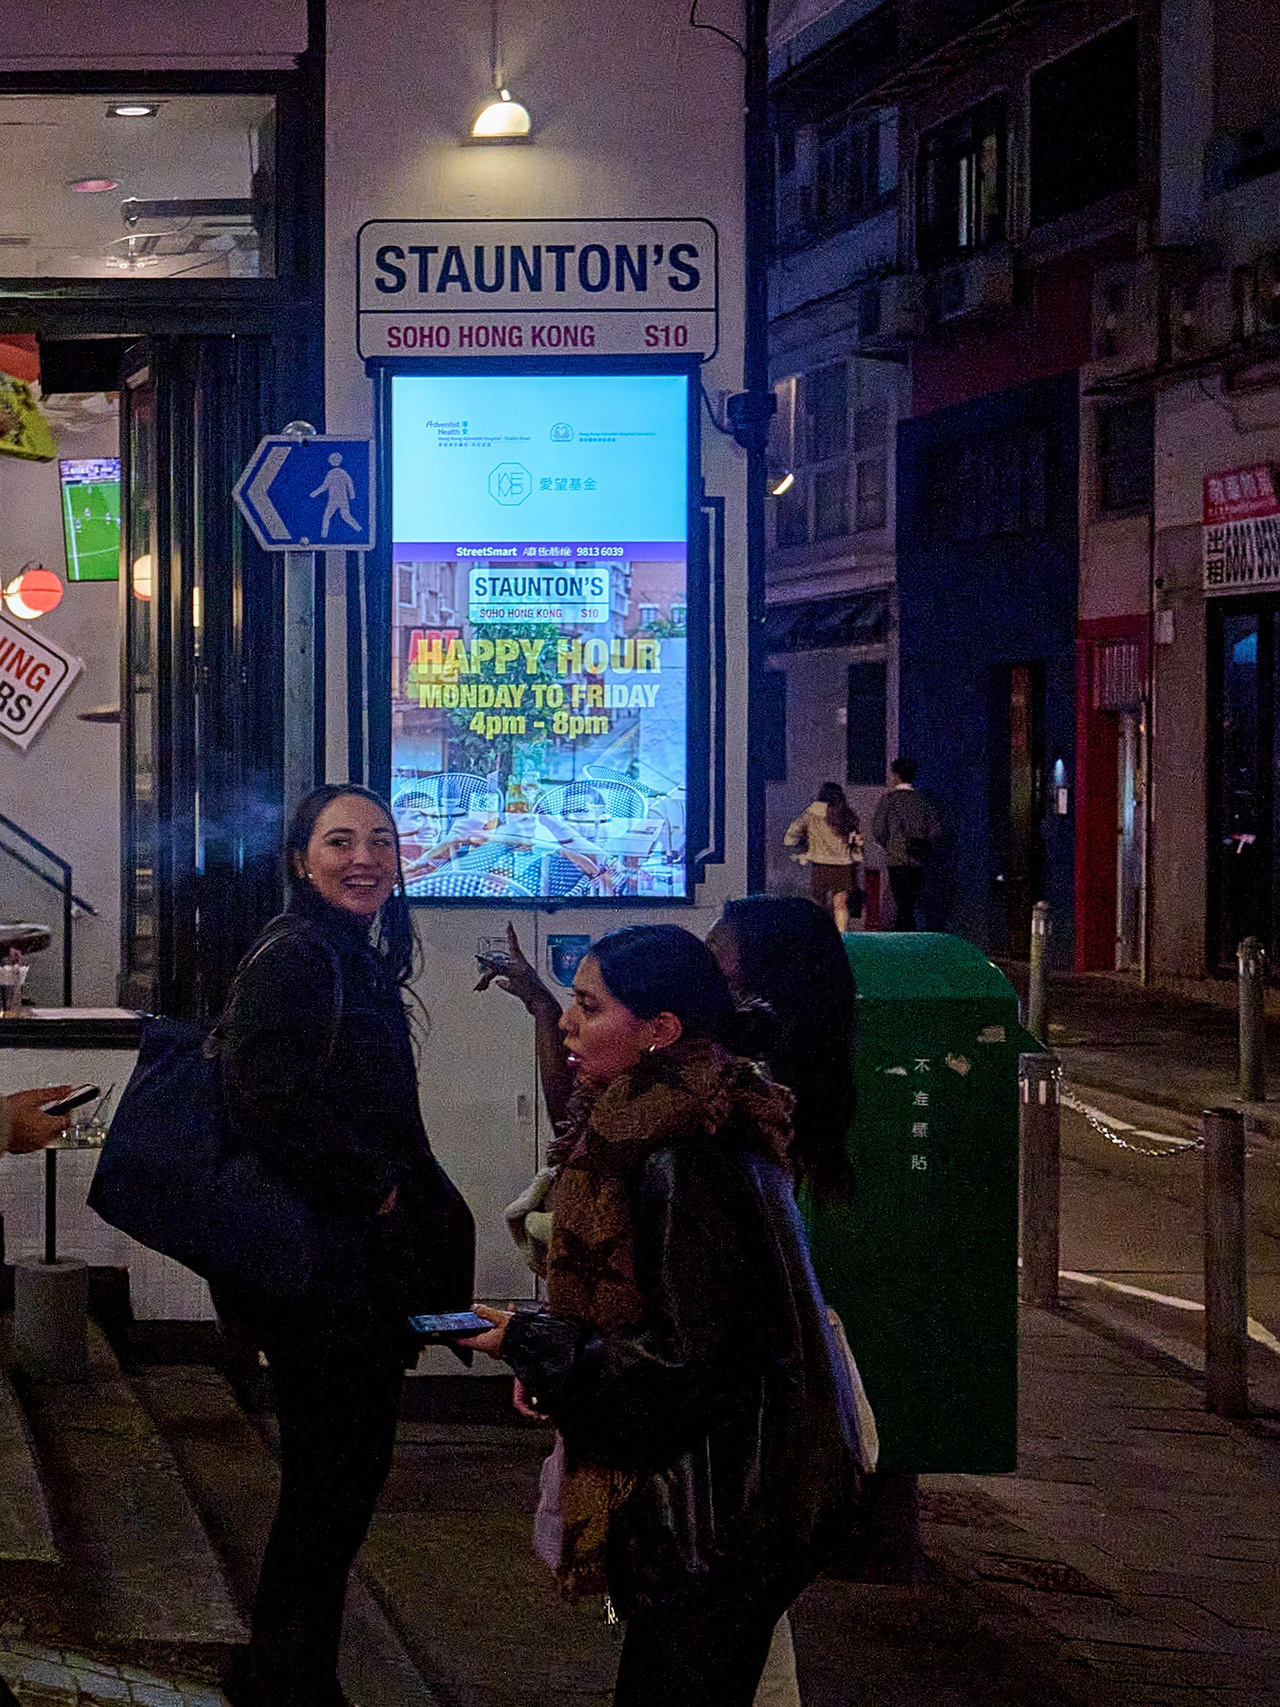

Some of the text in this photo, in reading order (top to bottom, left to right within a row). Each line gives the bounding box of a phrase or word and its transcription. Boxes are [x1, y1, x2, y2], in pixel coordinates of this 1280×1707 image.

[374, 243, 702, 295] STAUNTON'S
[387, 324, 689, 349] SOHO HONG KONG S10
[539, 477, 597, 491] 愛望基金
[455, 546, 517, 557] StreetSmart
[576, 546, 599, 557] 9813
[601, 546, 624, 557] 6039
[474, 576, 604, 597] STAUNTON'S
[479, 608, 599, 618] SOHO HONG KONG S10
[417, 638, 661, 675] HAPPY HOUR
[418, 683, 661, 709] MONDAY TO FRIDAY
[469, 711, 525, 740] 4pm
[552, 711, 609, 740] 8pm
